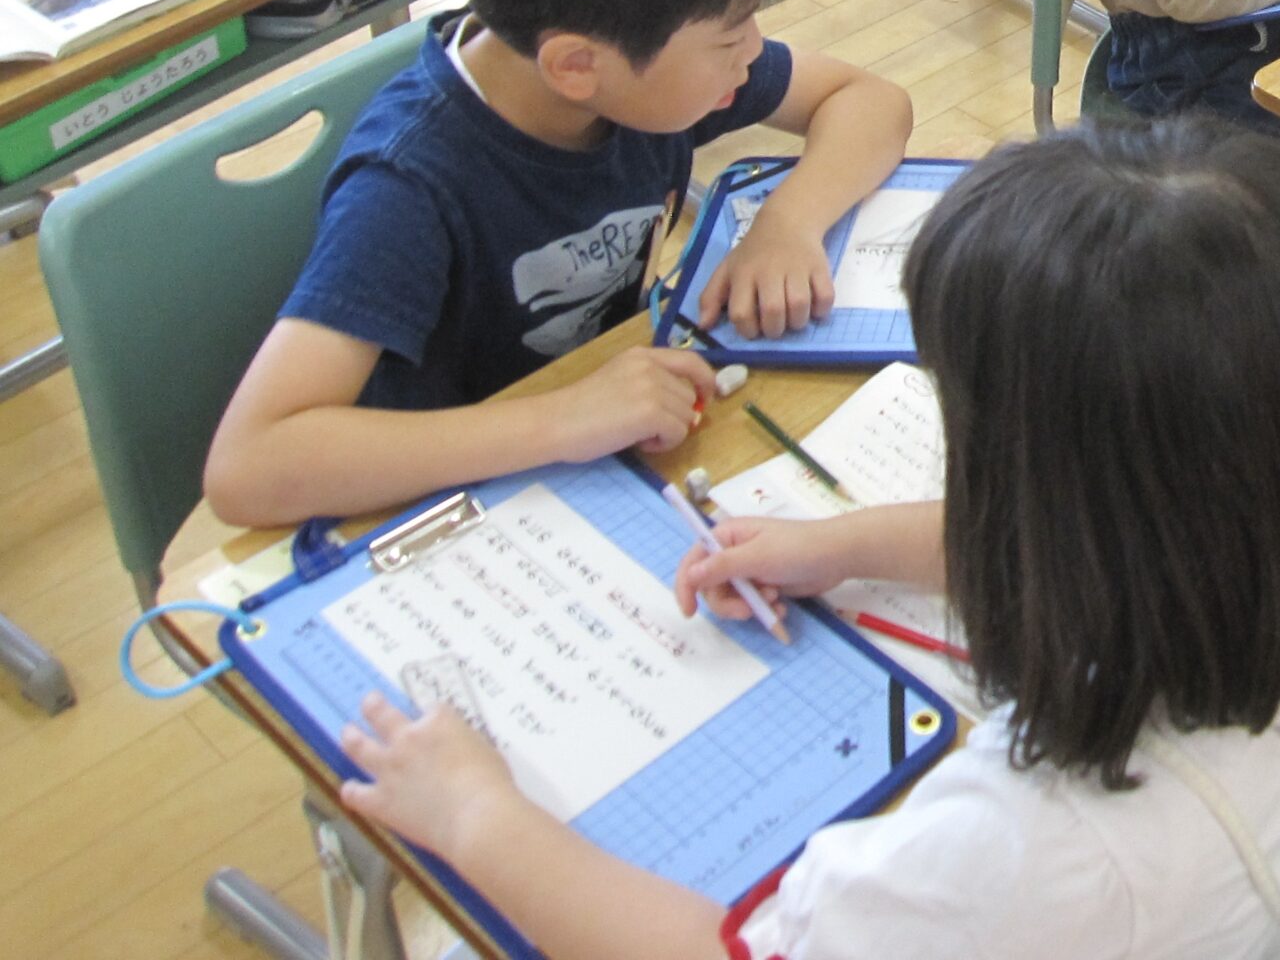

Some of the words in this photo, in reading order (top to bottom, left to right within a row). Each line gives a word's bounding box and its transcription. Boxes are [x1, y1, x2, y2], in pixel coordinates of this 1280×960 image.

[64, 103, 110, 138] いとう
[121, 48, 208, 105] じょうたろう
